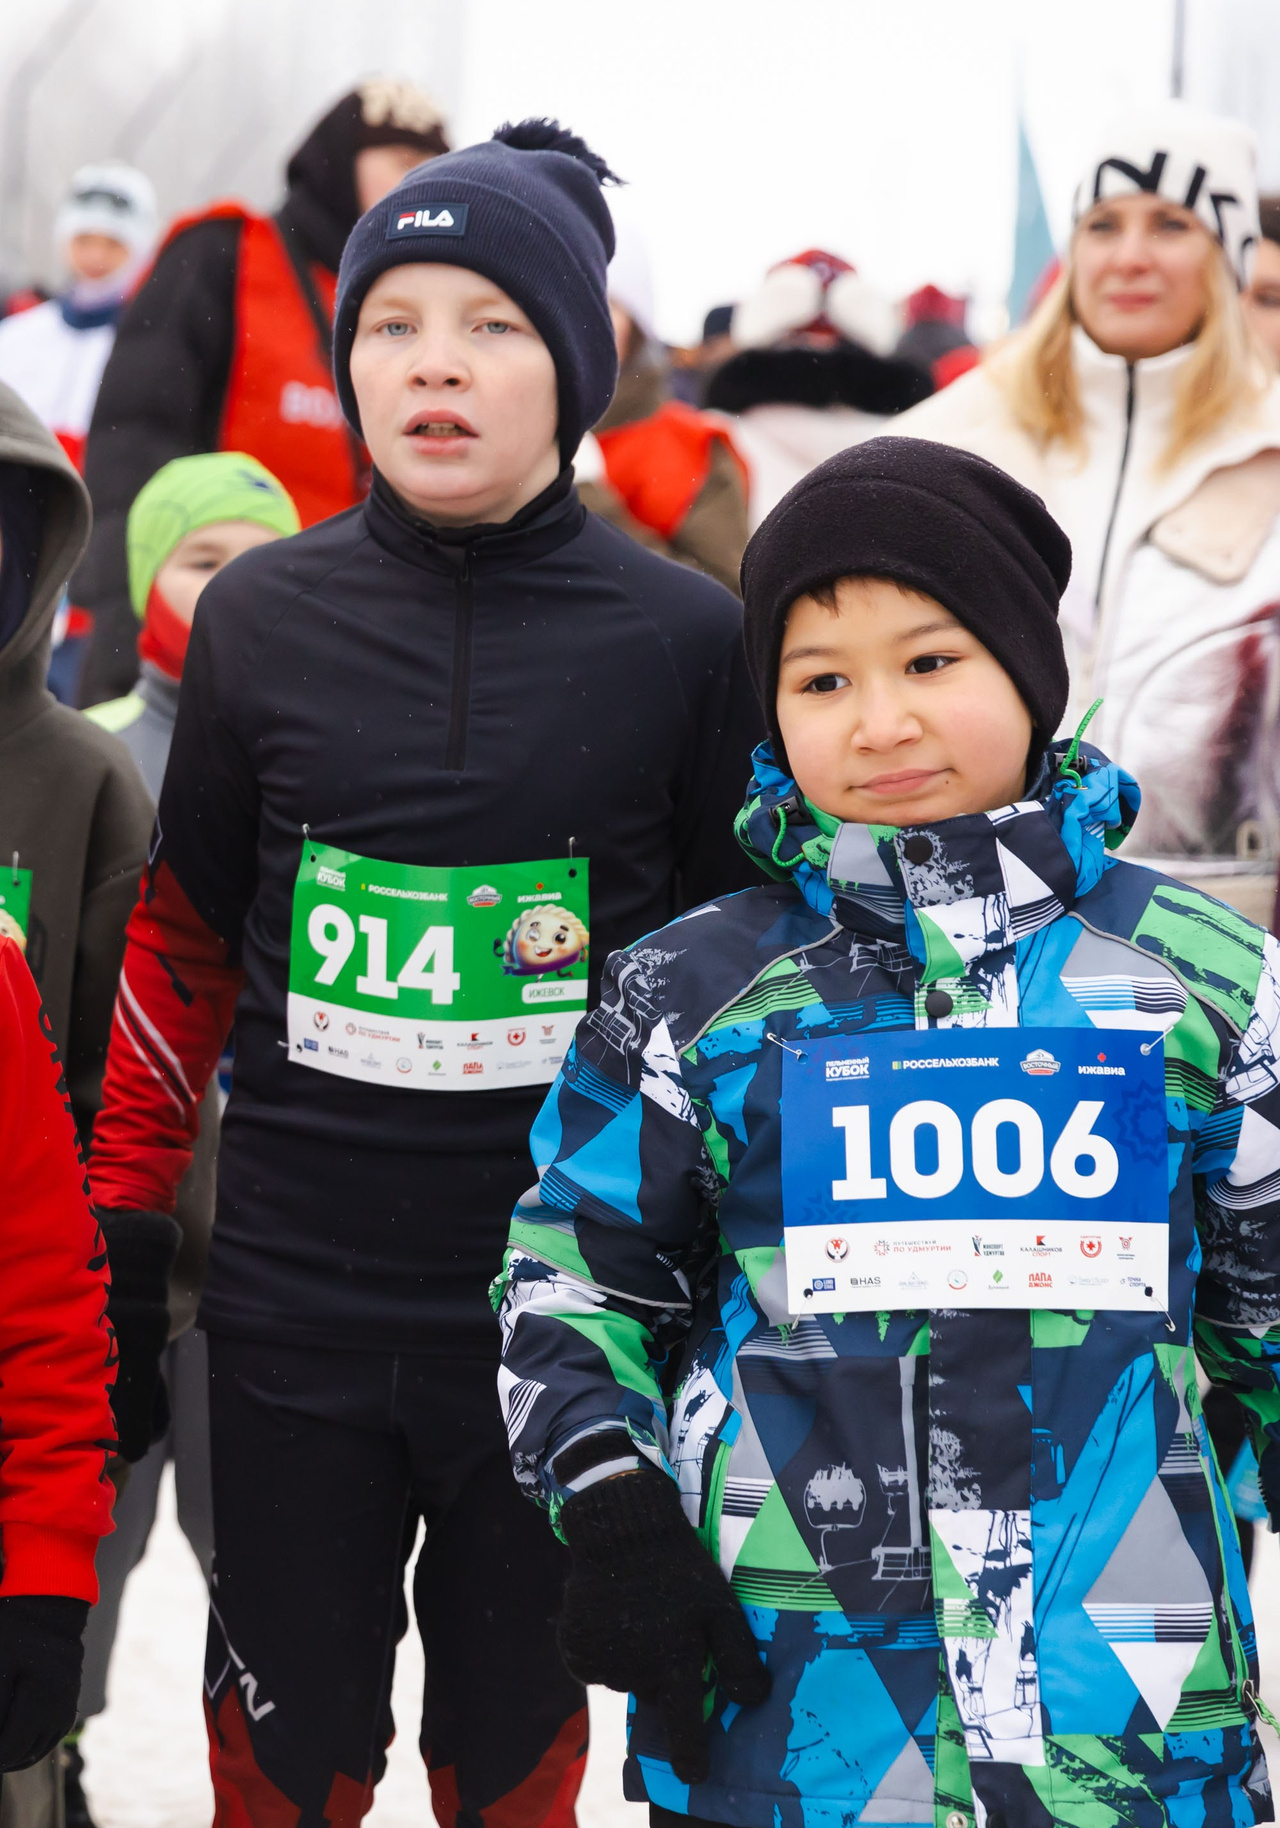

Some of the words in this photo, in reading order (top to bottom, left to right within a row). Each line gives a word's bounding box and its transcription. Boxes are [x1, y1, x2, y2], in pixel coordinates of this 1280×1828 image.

[397, 209, 454, 230] FILA
[368, 884, 448, 902] РОССЕЛЬХОЗБАНК
[307, 904, 460, 1005] 914
[528, 986, 565, 998] ИЖЕВСК
[903, 1057, 999, 1070] РОССЕЛЬХОЗБАНК
[826, 1064, 870, 1078] КУБОК
[1077, 1065, 1126, 1076] ижавиа
[832, 1098, 1119, 1201] 1006
[907, 1245, 952, 1253] УДМУРТИИ
[859, 1276, 881, 1285] HAS
[1028, 1272, 1052, 1282] ПАПА
